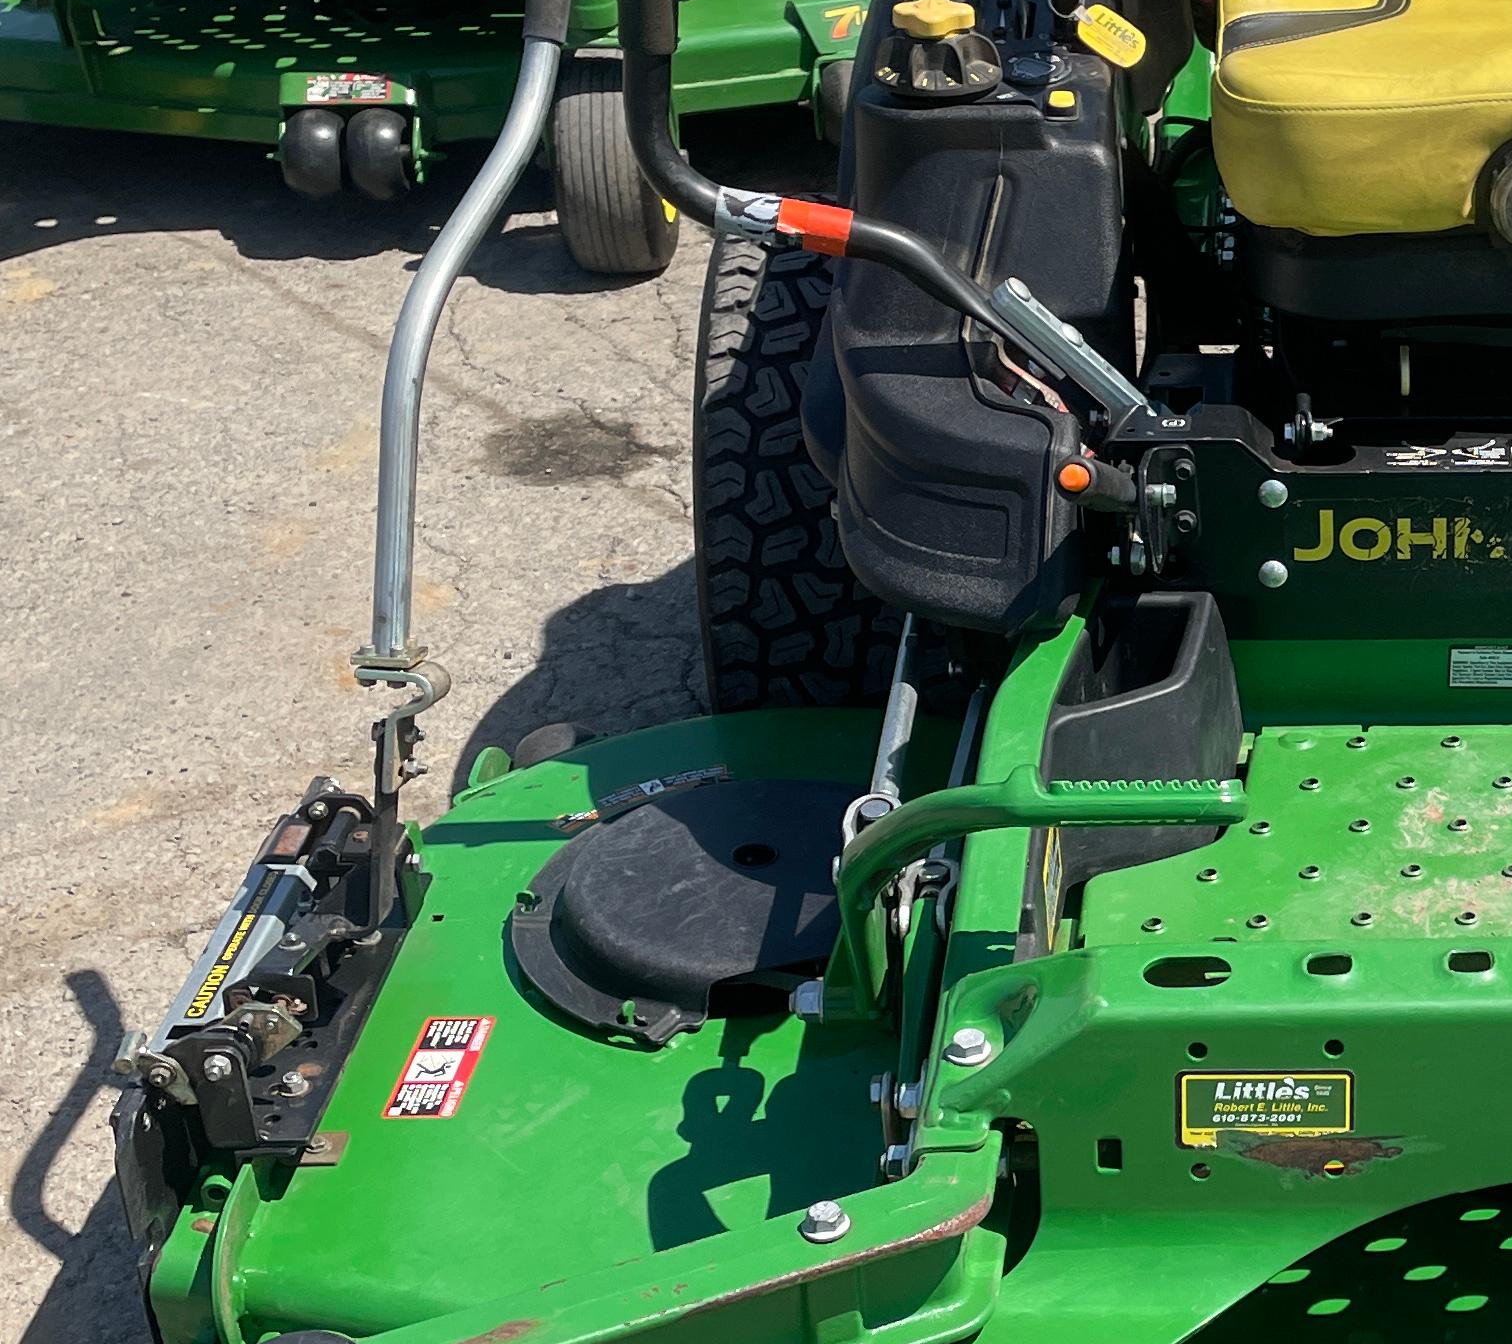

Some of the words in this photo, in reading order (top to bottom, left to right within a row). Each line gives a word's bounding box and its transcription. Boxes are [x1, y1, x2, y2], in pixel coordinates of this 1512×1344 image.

[187, 964, 230, 1018] CAUTION
[1214, 1102, 1254, 1112] Robert
[1307, 1102, 1329, 1112] Inc.
